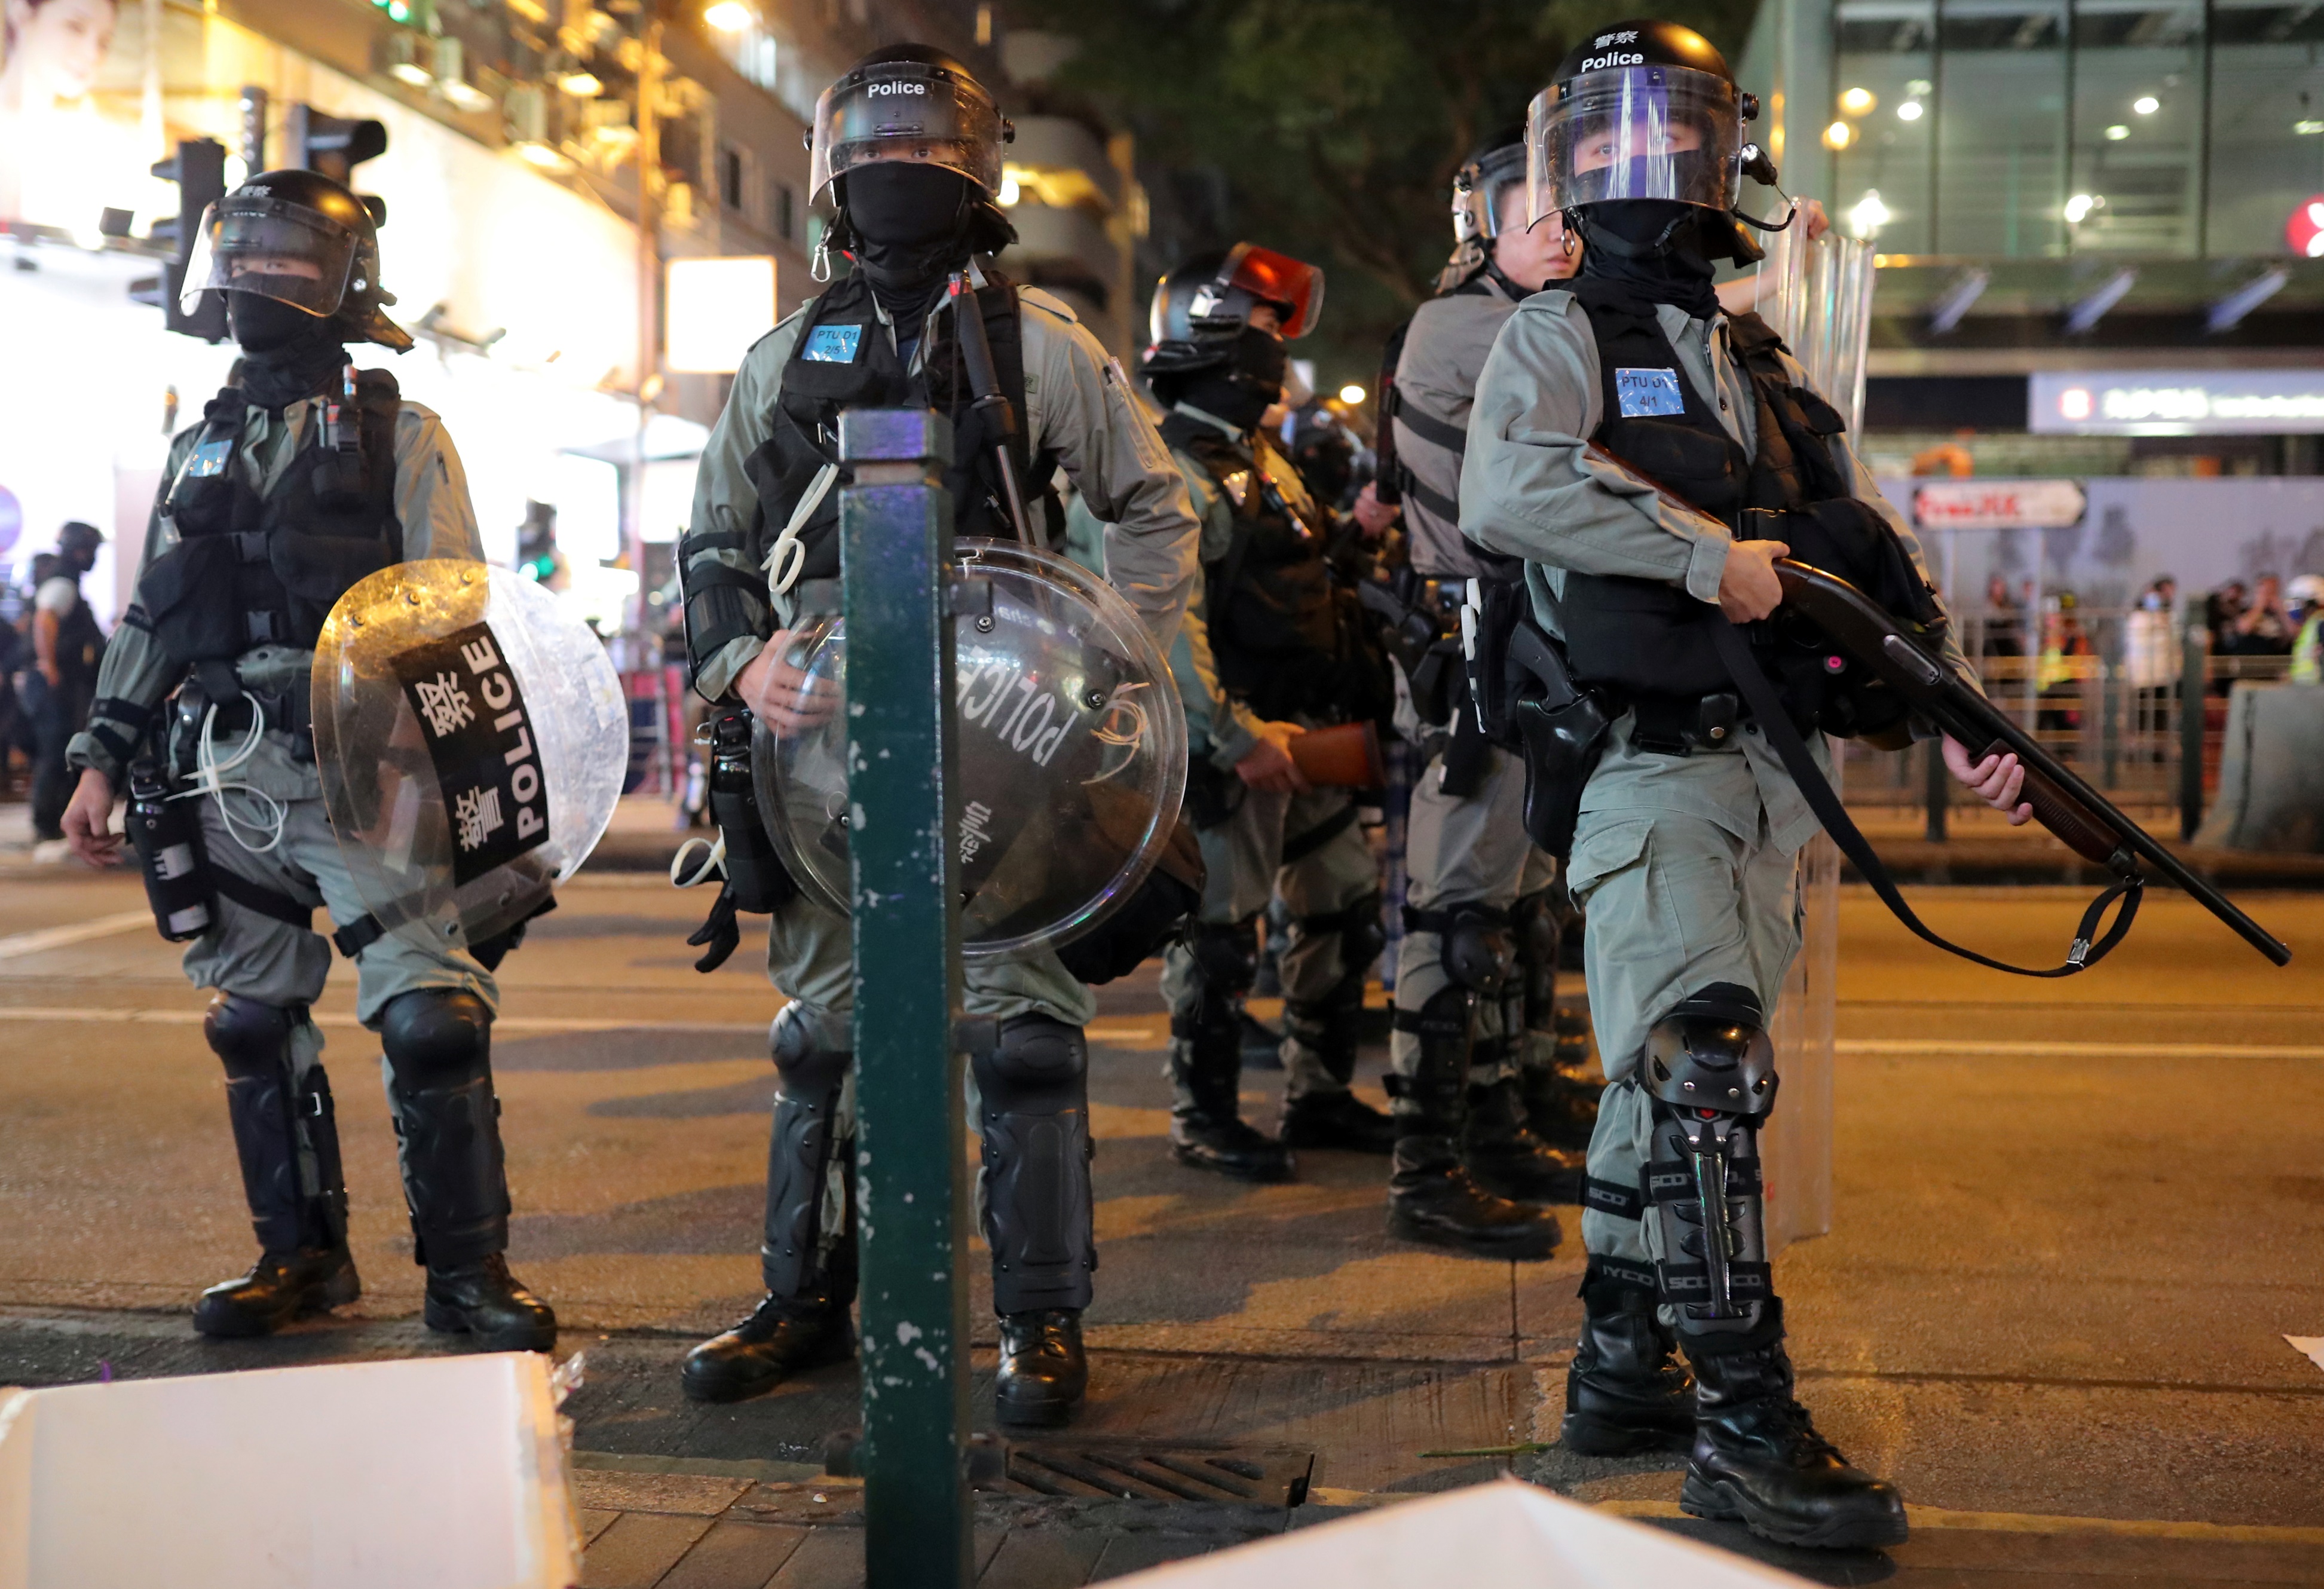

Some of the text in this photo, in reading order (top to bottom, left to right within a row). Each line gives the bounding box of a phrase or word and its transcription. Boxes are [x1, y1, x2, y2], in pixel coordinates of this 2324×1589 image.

[1593, 30, 1639, 49] 警察
[1581, 51, 1644, 73] Police
[868, 81, 925, 98] Police
[817, 330, 858, 340] PTU D1
[825, 345, 841, 354] 2/5
[1622, 376, 1648, 388] PTU
[1640, 396, 1657, 407] 4/1
[956, 645, 1079, 767] POLICE
[461, 635, 544, 840] POLICE
[415, 670, 504, 852] 警察
